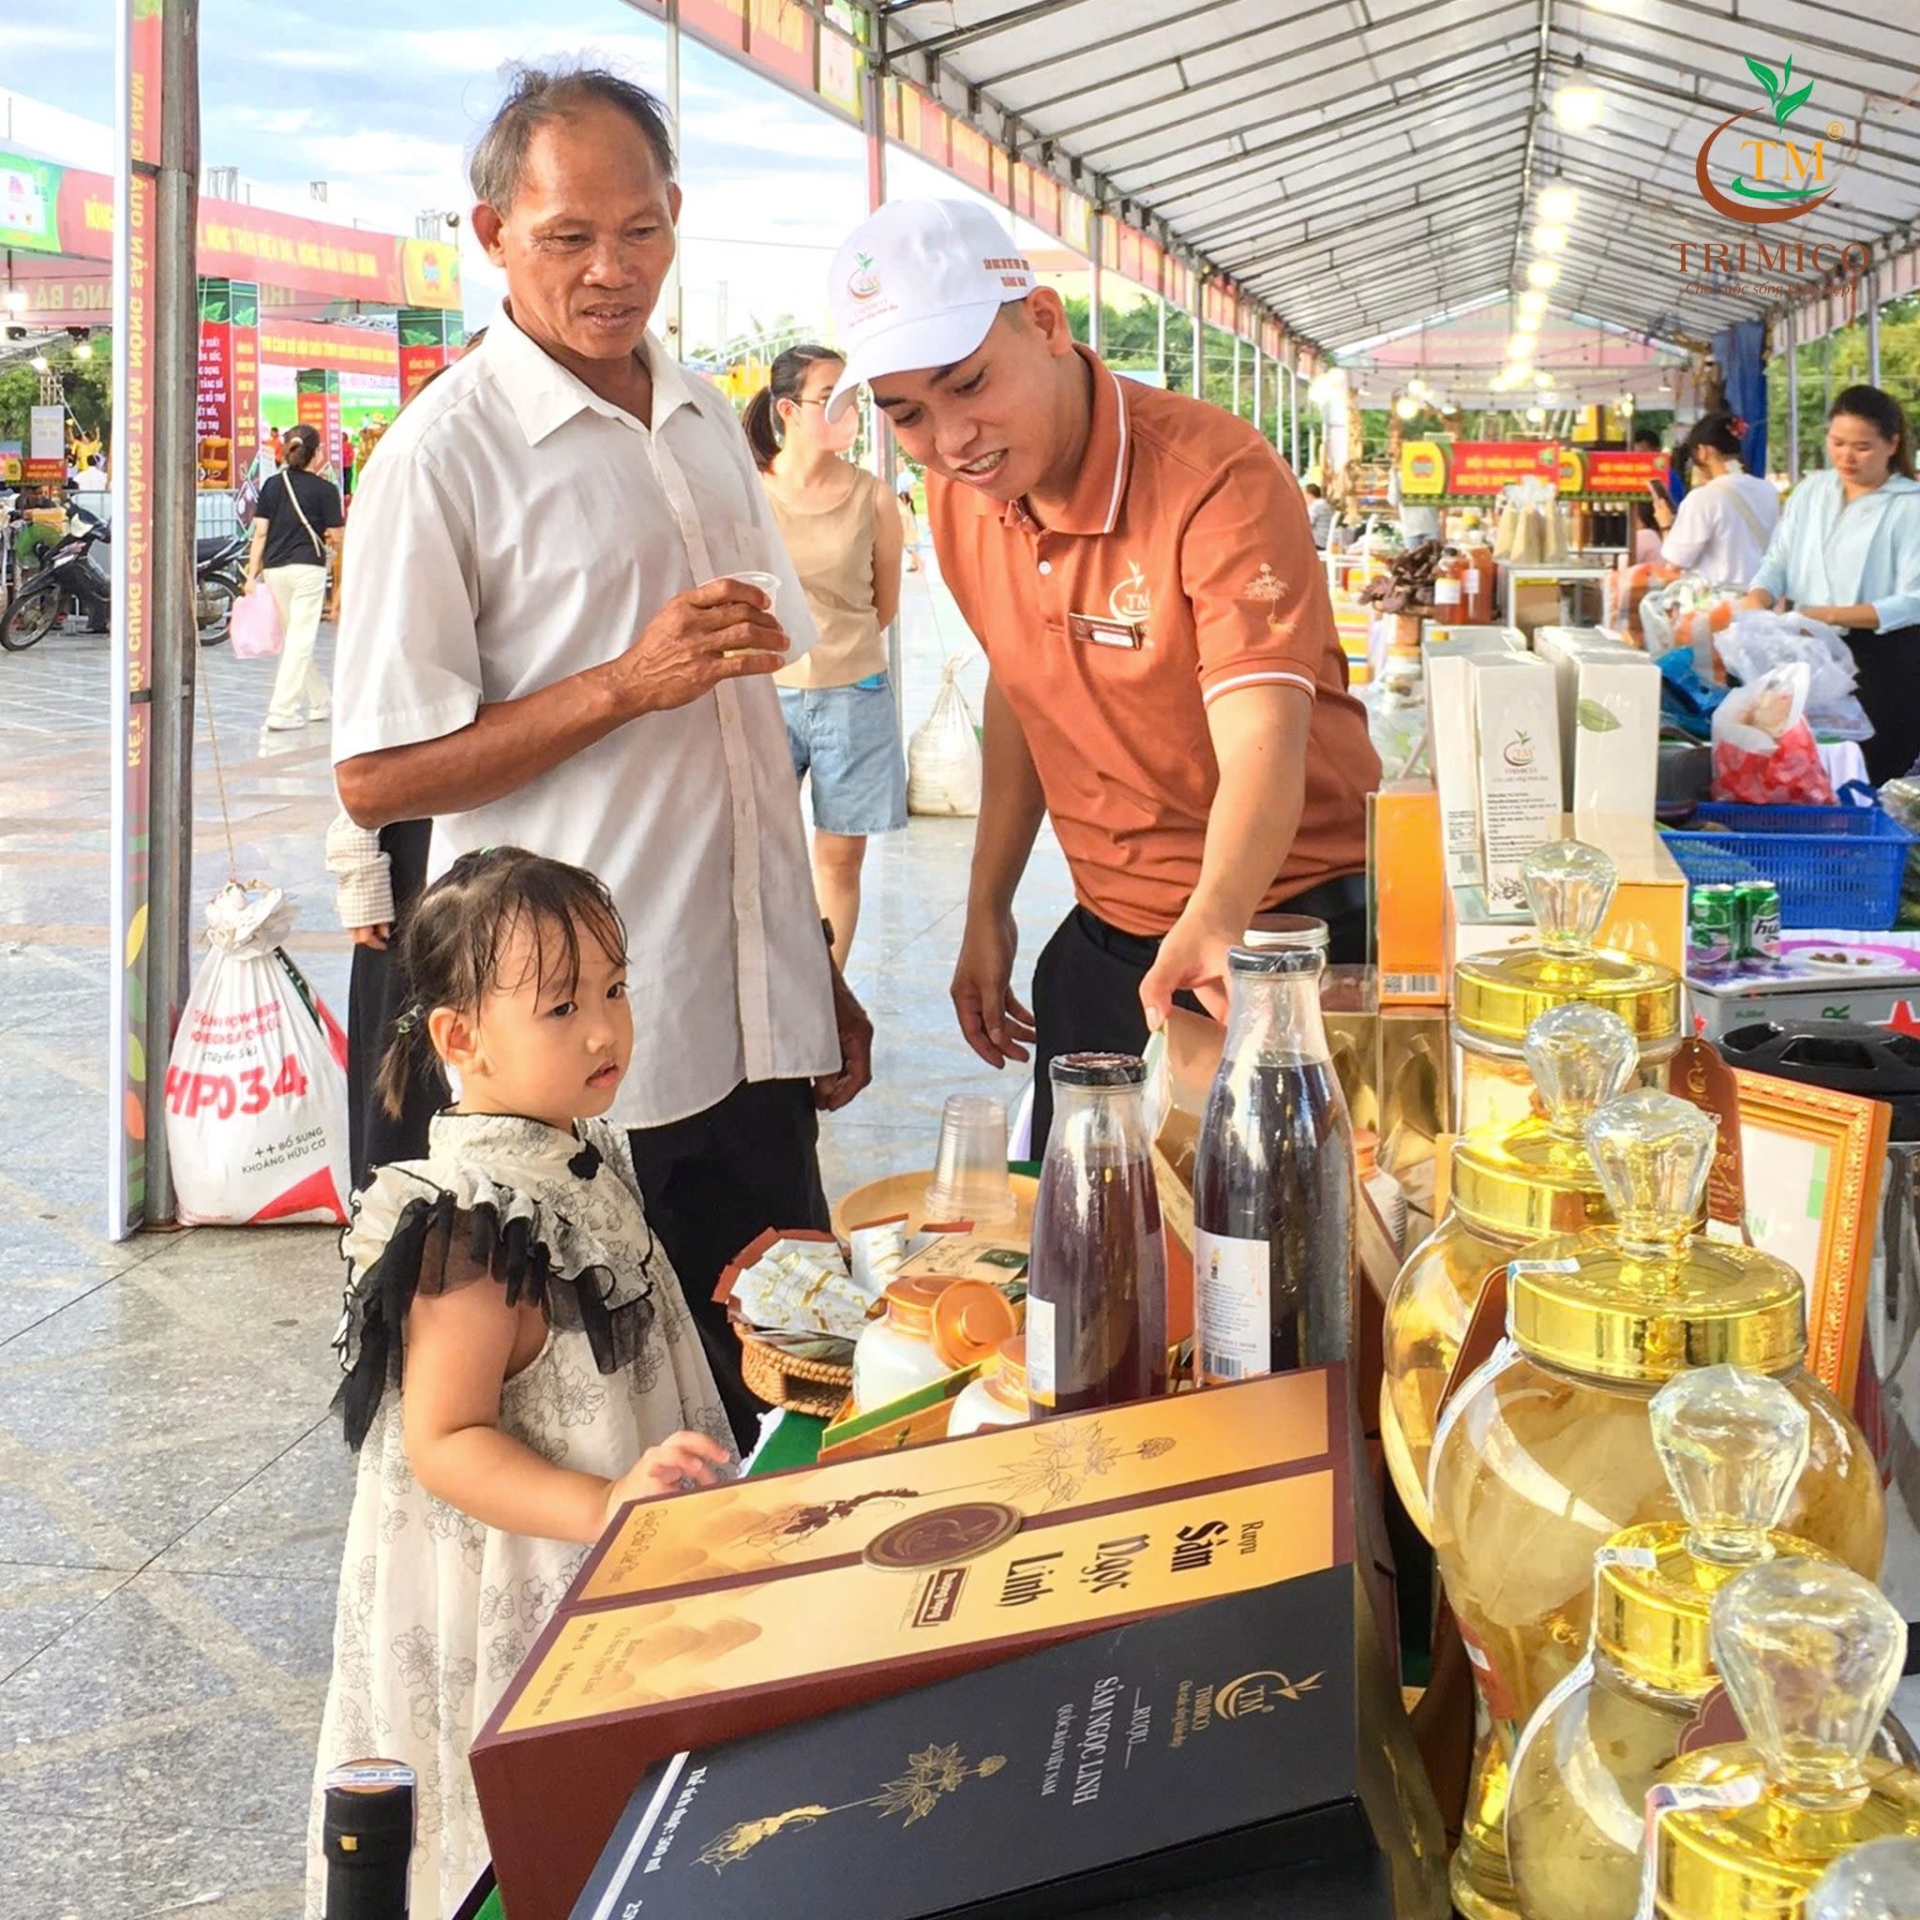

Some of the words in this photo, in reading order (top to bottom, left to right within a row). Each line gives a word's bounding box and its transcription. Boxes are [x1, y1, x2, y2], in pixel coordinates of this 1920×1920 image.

[295, 1126, 324, 1145] SUNG
[1170, 1520, 1230, 1573] Sâm
[1239, 1519, 1265, 1556] Rượu
[993, 1550, 1065, 1608] Linh
[1078, 1533, 1151, 1594] Ngọc
[1090, 1676, 1125, 1713] SÂM
[1191, 1684, 1214, 1732] TRIMICO
[1237, 1683, 1267, 1717] TM
[1076, 1709, 1114, 1760] NGỌC
[1124, 1705, 1152, 1745] RƯỢU
[675, 1787, 699, 1809] tích
[1041, 1771, 1060, 1797] NAM
[1071, 1758, 1105, 1806] LINH
[643, 1856, 663, 1875] ml
